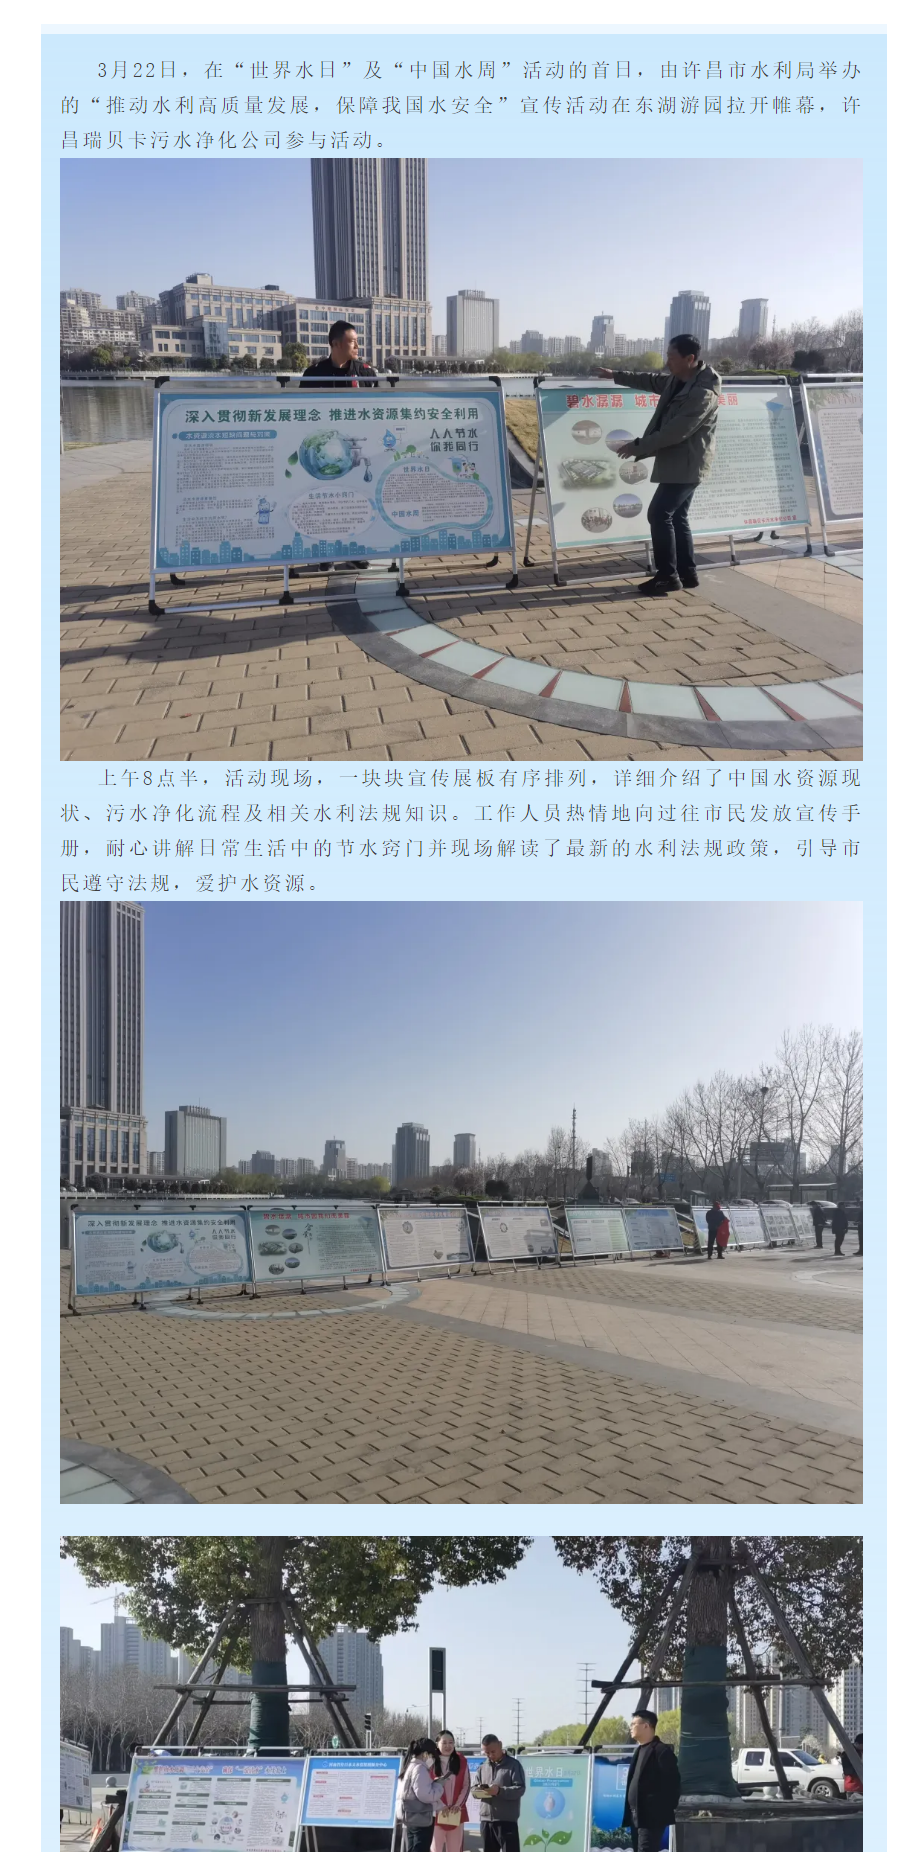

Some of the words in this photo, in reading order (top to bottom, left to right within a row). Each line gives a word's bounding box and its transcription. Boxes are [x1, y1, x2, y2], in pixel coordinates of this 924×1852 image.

[566, 393, 624, 409] 碧水潺潺
[185, 408, 322, 423] 深入贯彻新发展理念
[329, 407, 479, 421] 推进水资源集约安全利用
[430, 428, 478, 439] 人人节水
[430, 440, 479, 452] 你我同行
[403, 465, 430, 473] 世界水日
[308, 490, 355, 500] 生活节水小窍门
[391, 509, 420, 518] 中国水周
[525, 1766, 563, 1778] 世界水日
